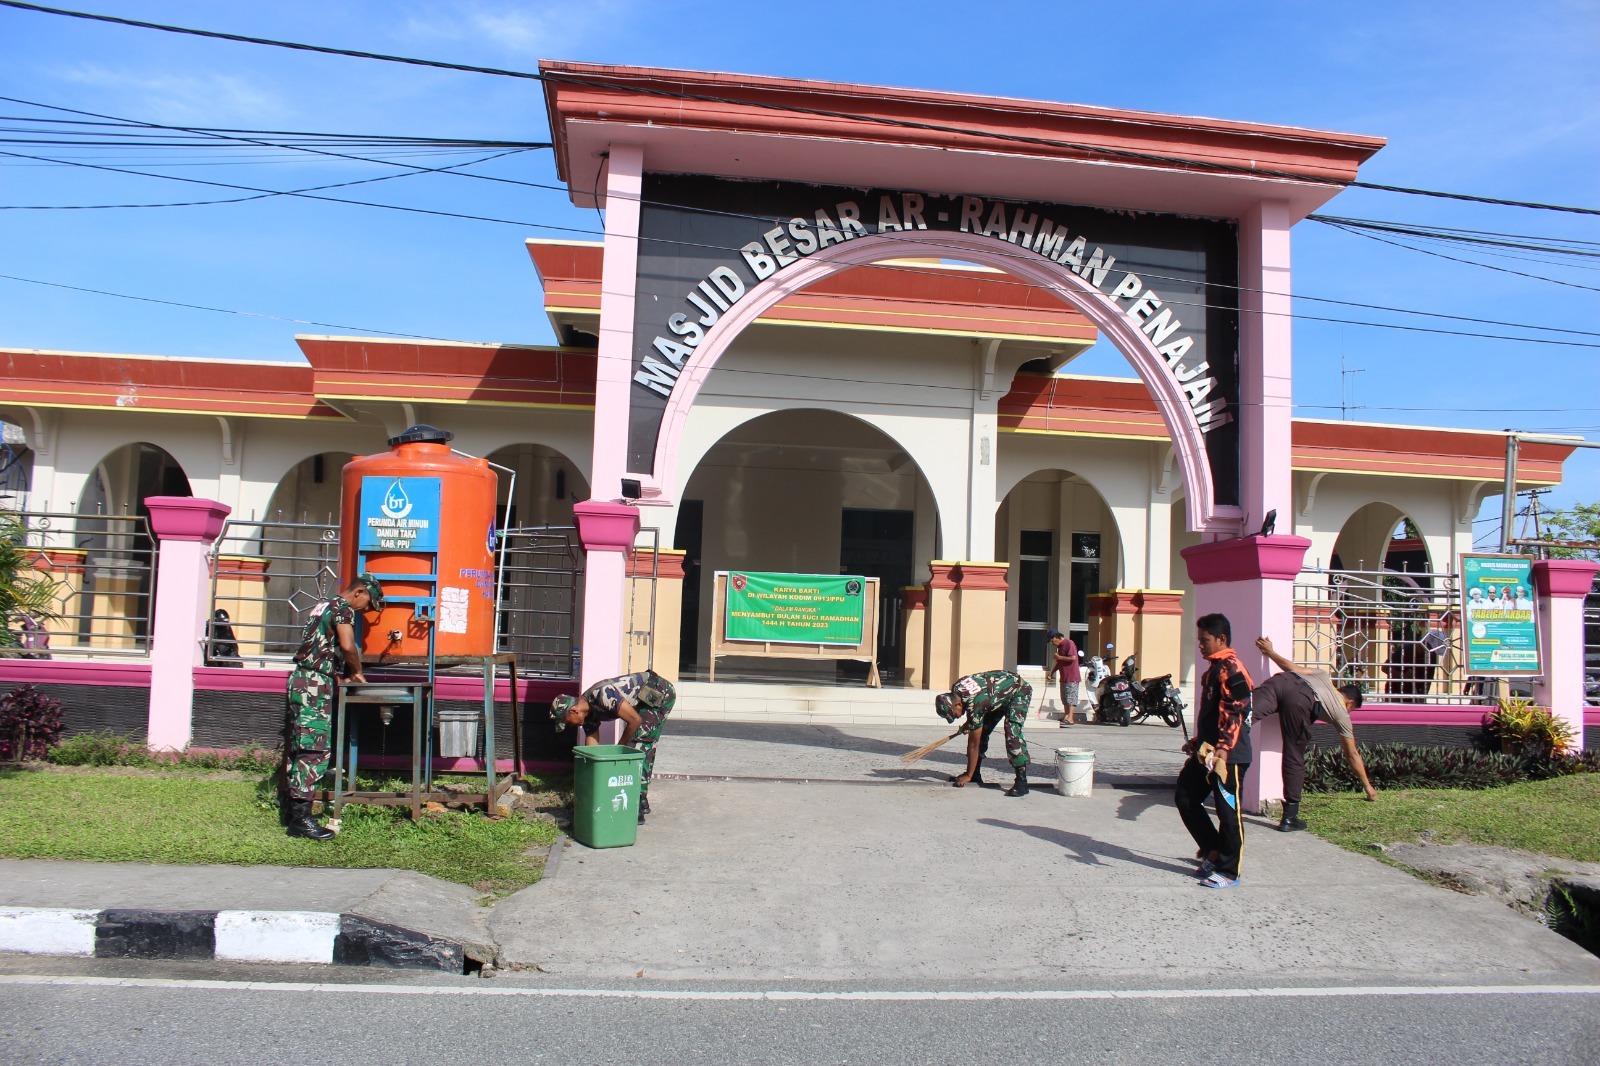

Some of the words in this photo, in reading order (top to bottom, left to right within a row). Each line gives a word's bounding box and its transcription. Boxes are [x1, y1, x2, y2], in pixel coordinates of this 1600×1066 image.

[633, 266, 745, 396] MASJID
[740, 201, 869, 281] BESAR
[878, 193, 928, 234] AR
[960, 195, 1116, 288] RAHMAN
[1109, 273, 1234, 434] PENAJAM
[367, 517, 395, 528] PERUMDA
[397, 519, 407, 528] AIR
[408, 519, 429, 529] MINUM
[376, 528, 398, 538] DANUM
[400, 529, 417, 539] TAKA
[397, 540, 410, 549] PPU
[731, 611, 775, 619] MENYAMBUT
[1471, 609, 1504, 620] TABLIGH
[1505, 610, 1531, 620] AKBAR
